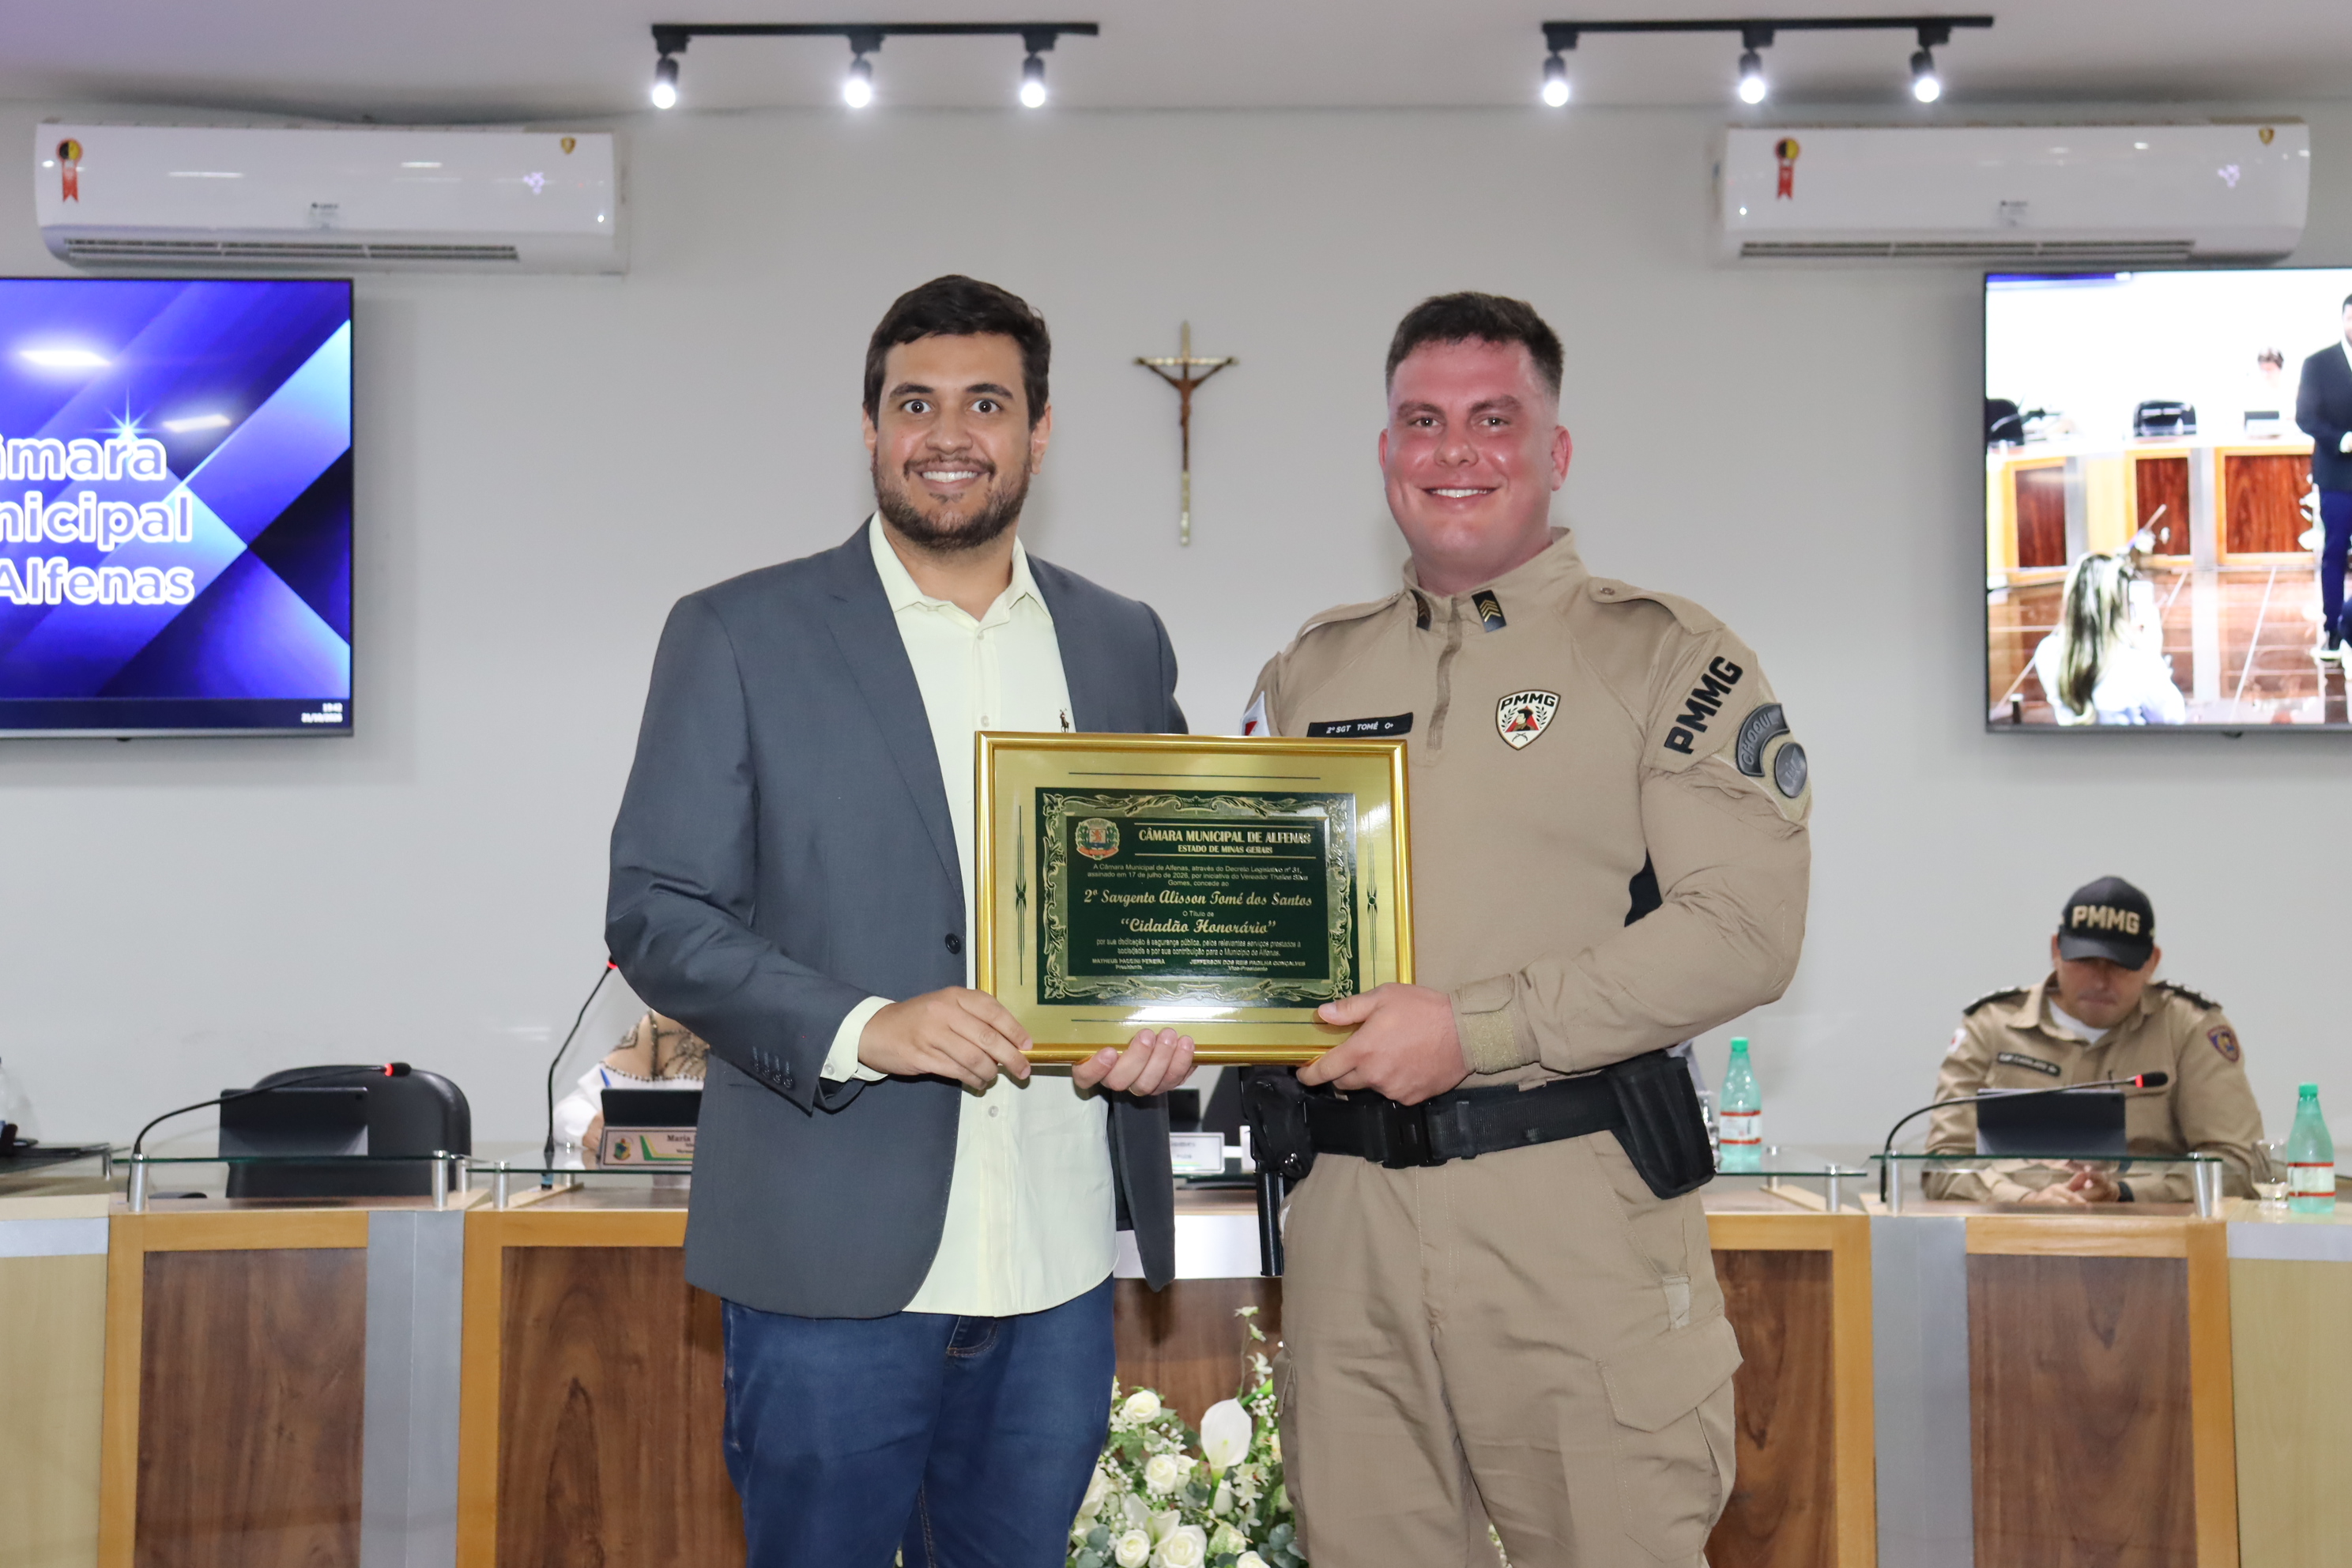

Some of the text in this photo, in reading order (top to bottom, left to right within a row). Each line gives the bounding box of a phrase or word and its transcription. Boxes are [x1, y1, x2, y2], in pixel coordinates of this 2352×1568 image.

[0, 432, 167, 481] mara
[0, 556, 195, 605] Alfenas
[1500, 693, 1556, 711] PMMG
[1664, 656, 1743, 755] PMMG
[1336, 725, 1351, 733] SGT
[1357, 721, 1378, 730] TOMÉ
[1139, 827, 1312, 844] CÂMARA MUNICIPAL DE ALFENAS
[1101, 889, 1156, 907] Sargento
[1159, 890, 1207, 904] Alisson
[1210, 891, 1243, 905] Tomé
[1246, 891, 1267, 905] dos
[1272, 892, 1312, 906] Santos
[2071, 905, 2140, 935] PMMG
[1118, 937, 1145, 947] dedicação
[1152, 939, 1179, 948] segurança
[1172, 948, 1204, 956] contribuição
